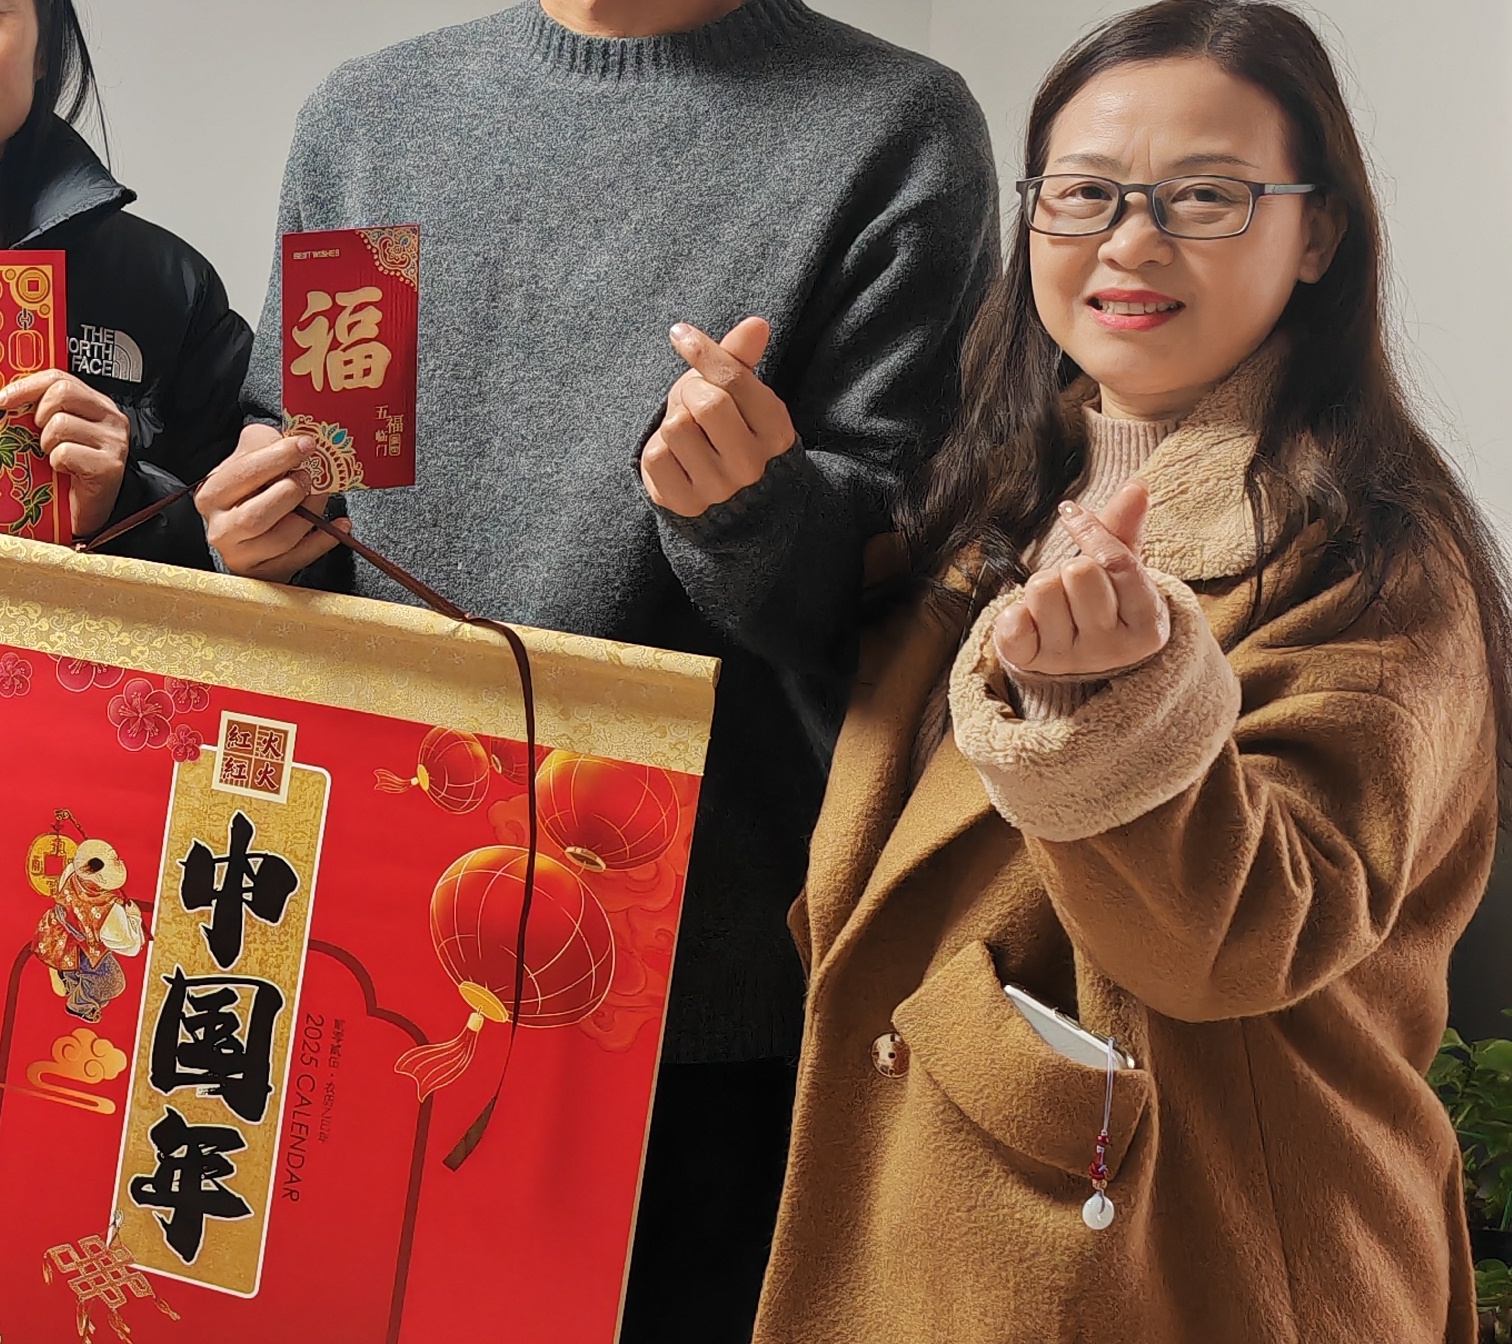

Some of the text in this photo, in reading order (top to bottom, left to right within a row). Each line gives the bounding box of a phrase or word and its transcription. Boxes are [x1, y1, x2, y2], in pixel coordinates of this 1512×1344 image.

[80, 324, 114, 344] THE
[290, 287, 392, 392] 福
[67, 336, 113, 361] ORTH
[72, 355, 113, 377] FACE
[281, 1012, 325, 1202] 2025 CALENDAR
